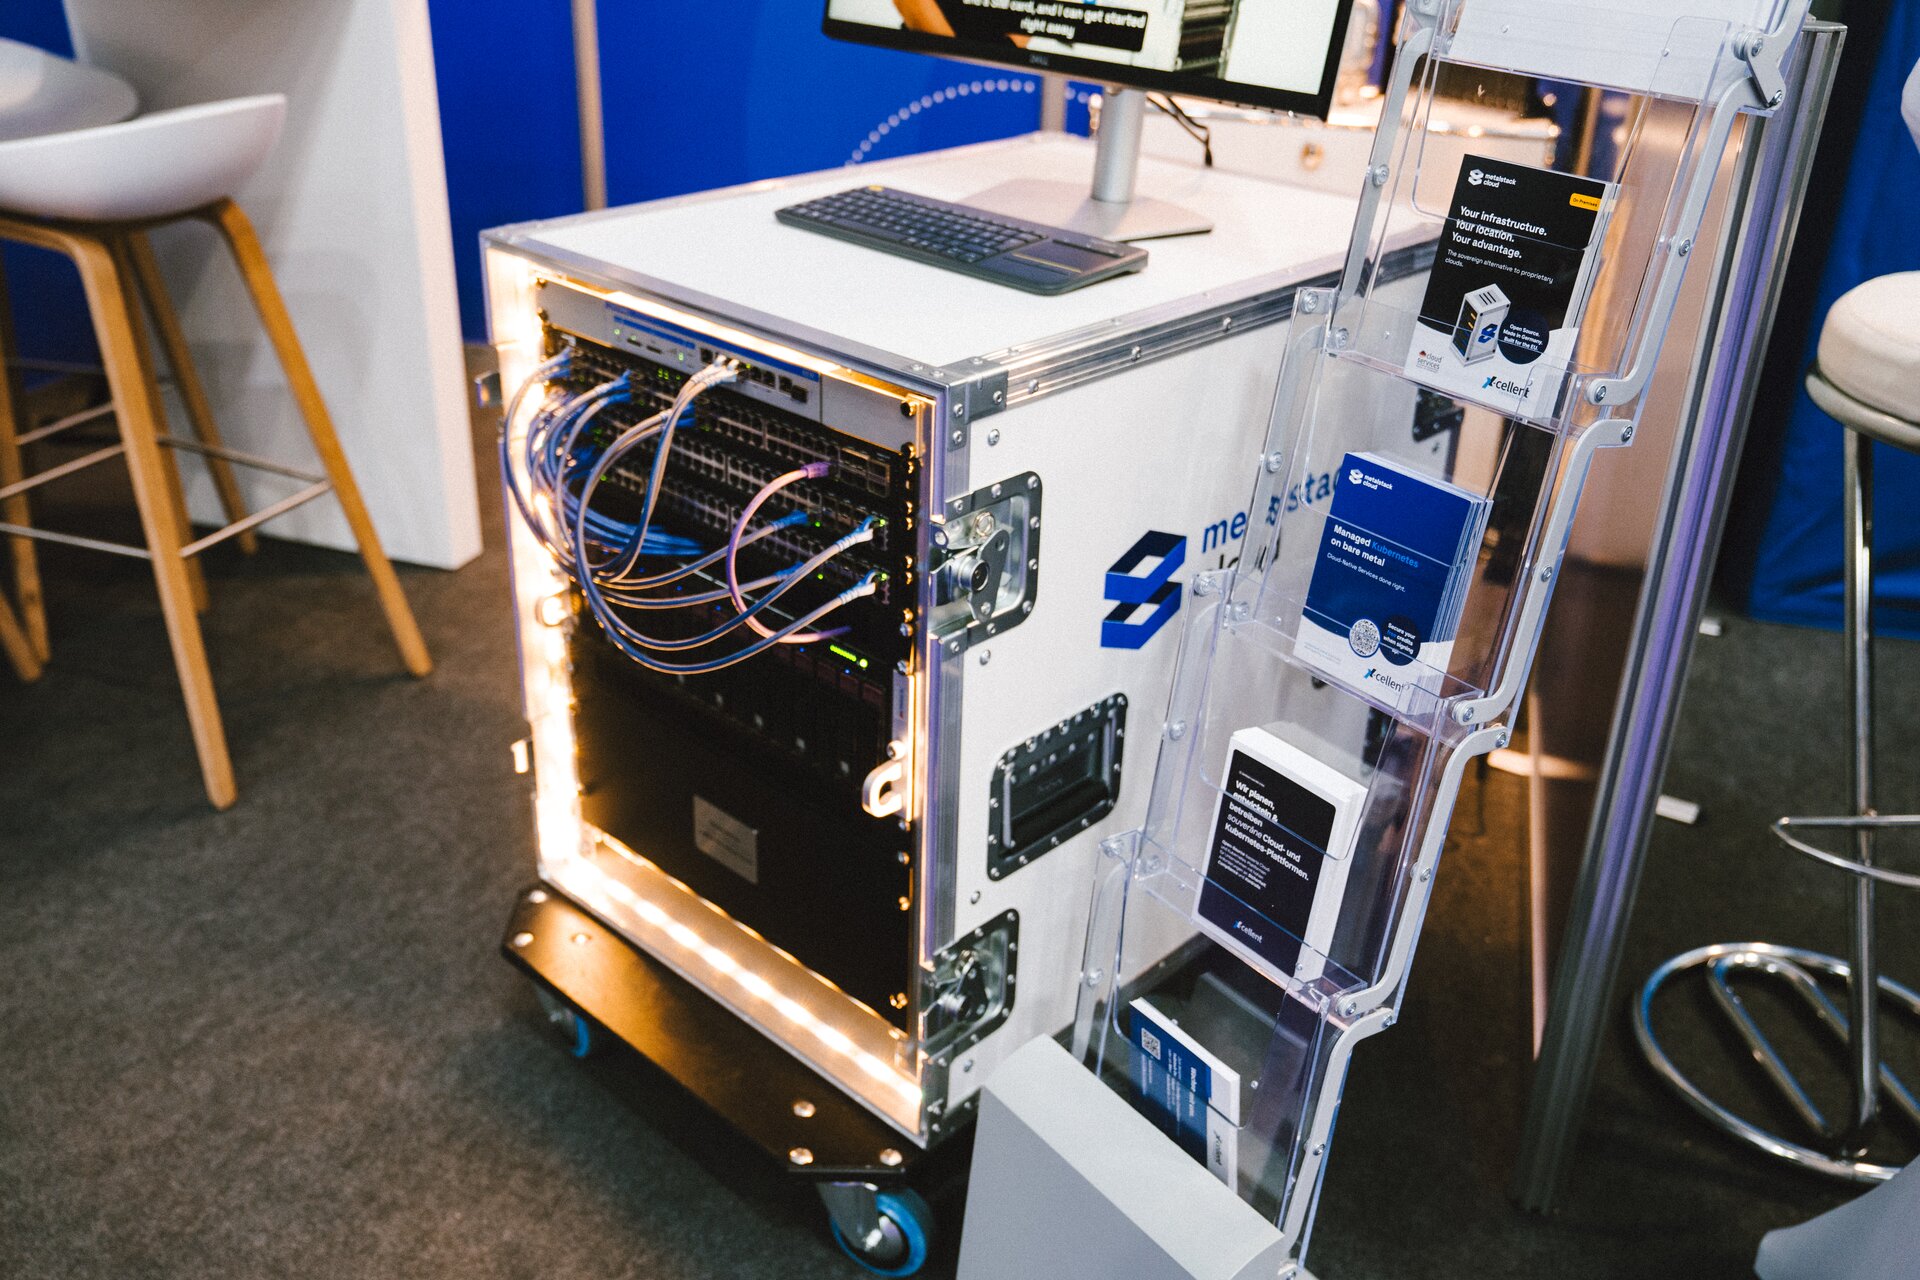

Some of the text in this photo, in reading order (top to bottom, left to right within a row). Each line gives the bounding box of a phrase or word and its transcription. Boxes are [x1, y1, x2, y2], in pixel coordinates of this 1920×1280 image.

[1020, 18, 1076, 39] right away
[1036, 3, 1057, 16] and
[1063, 7, 1084, 20] can
[1084, 10, 1104, 24] get
[1104, 11, 1146, 29] started
[1483, 179, 1500, 189] cloud
[1484, 172, 1517, 186] metalstack
[1455, 219, 1515, 242] Your location.
[1460, 205, 1548, 236] Your infrastructure.
[1452, 231, 1522, 259] Your advantage.
[1444, 257, 1464, 267] clouds.
[1447, 249, 1457, 257] The
[1457, 252, 1484, 265] sovereign
[1483, 259, 1513, 272] alternative
[1520, 269, 1554, 284] proprietary
[1362, 480, 1378, 490] cloud
[1330, 538, 1386, 567] on bare metal
[1333, 524, 1419, 568] Managed Kubernetes
[1326, 552, 1406, 593] Cloud-Native Services done right.
[1232, 792, 1272, 820] entwickeln
[1235, 780, 1275, 811] Wir planen,
[1229, 801, 1263, 828] betreiben
[1224, 822, 1309, 881] Kubernetes-Plattformen.
[1262, 833, 1285, 852] Cloud-
[1286, 849, 1301, 863] und
